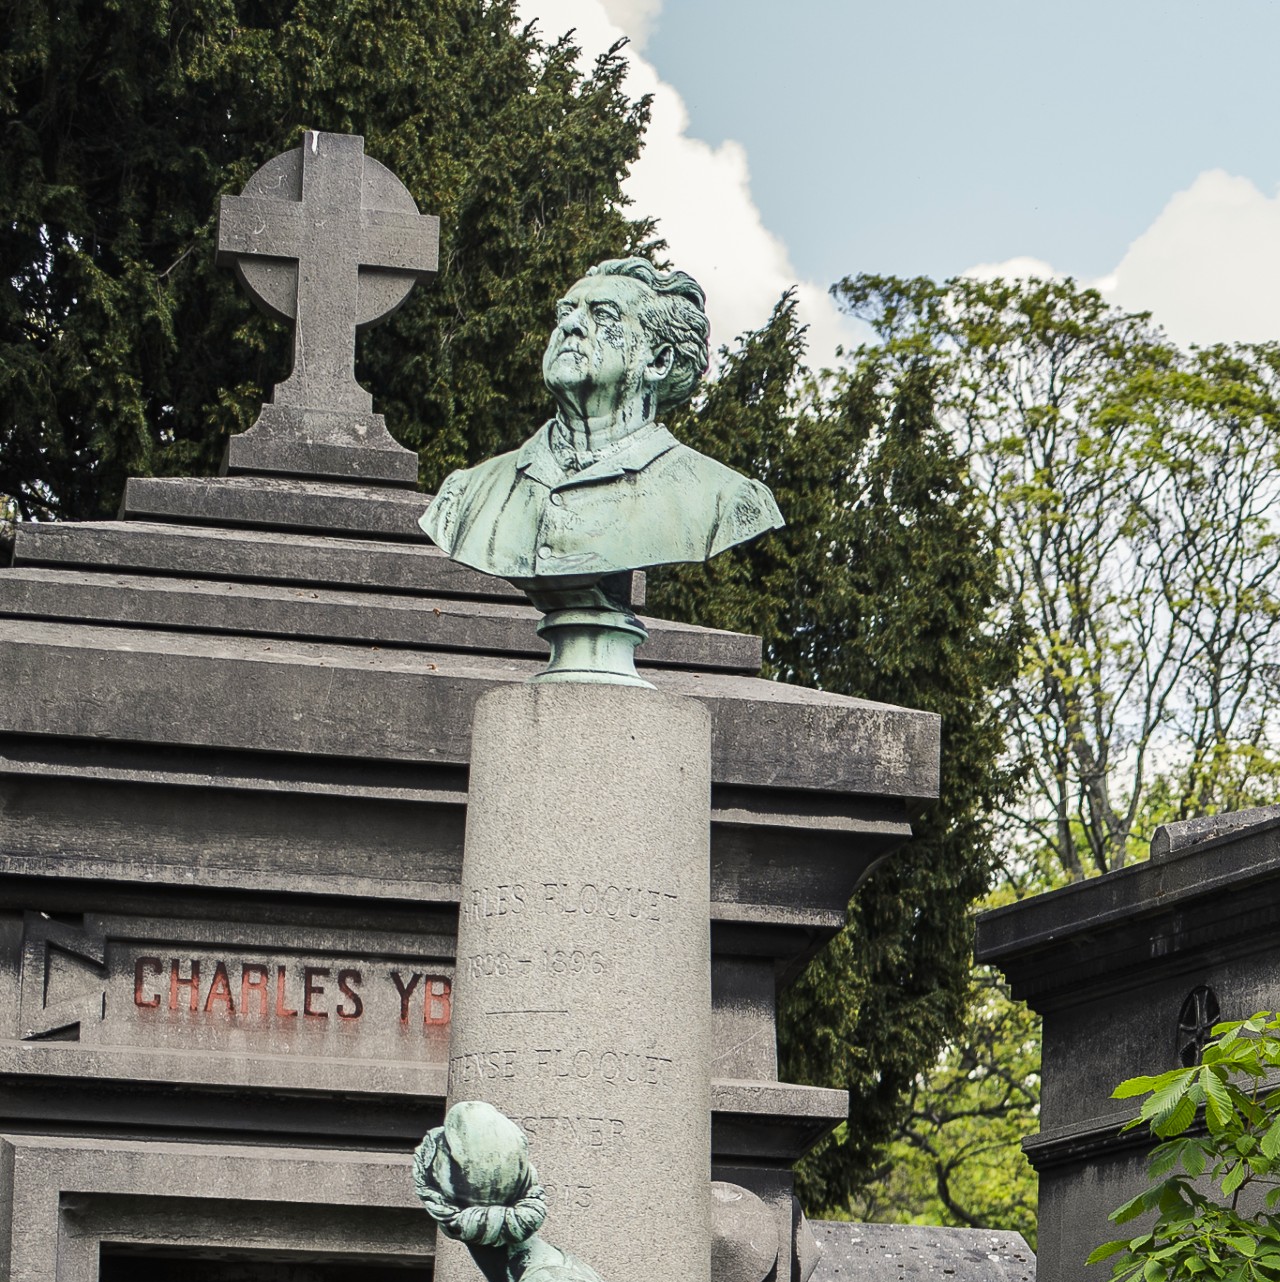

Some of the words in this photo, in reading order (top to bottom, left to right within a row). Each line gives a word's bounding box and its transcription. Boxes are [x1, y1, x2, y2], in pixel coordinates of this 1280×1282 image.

[541, 884, 677, 922] FLOQUET
[543, 950, 604, 975] 1896
[134, 956, 364, 1020] CHARLES
[535, 1050, 673, 1085] FLOQUET
